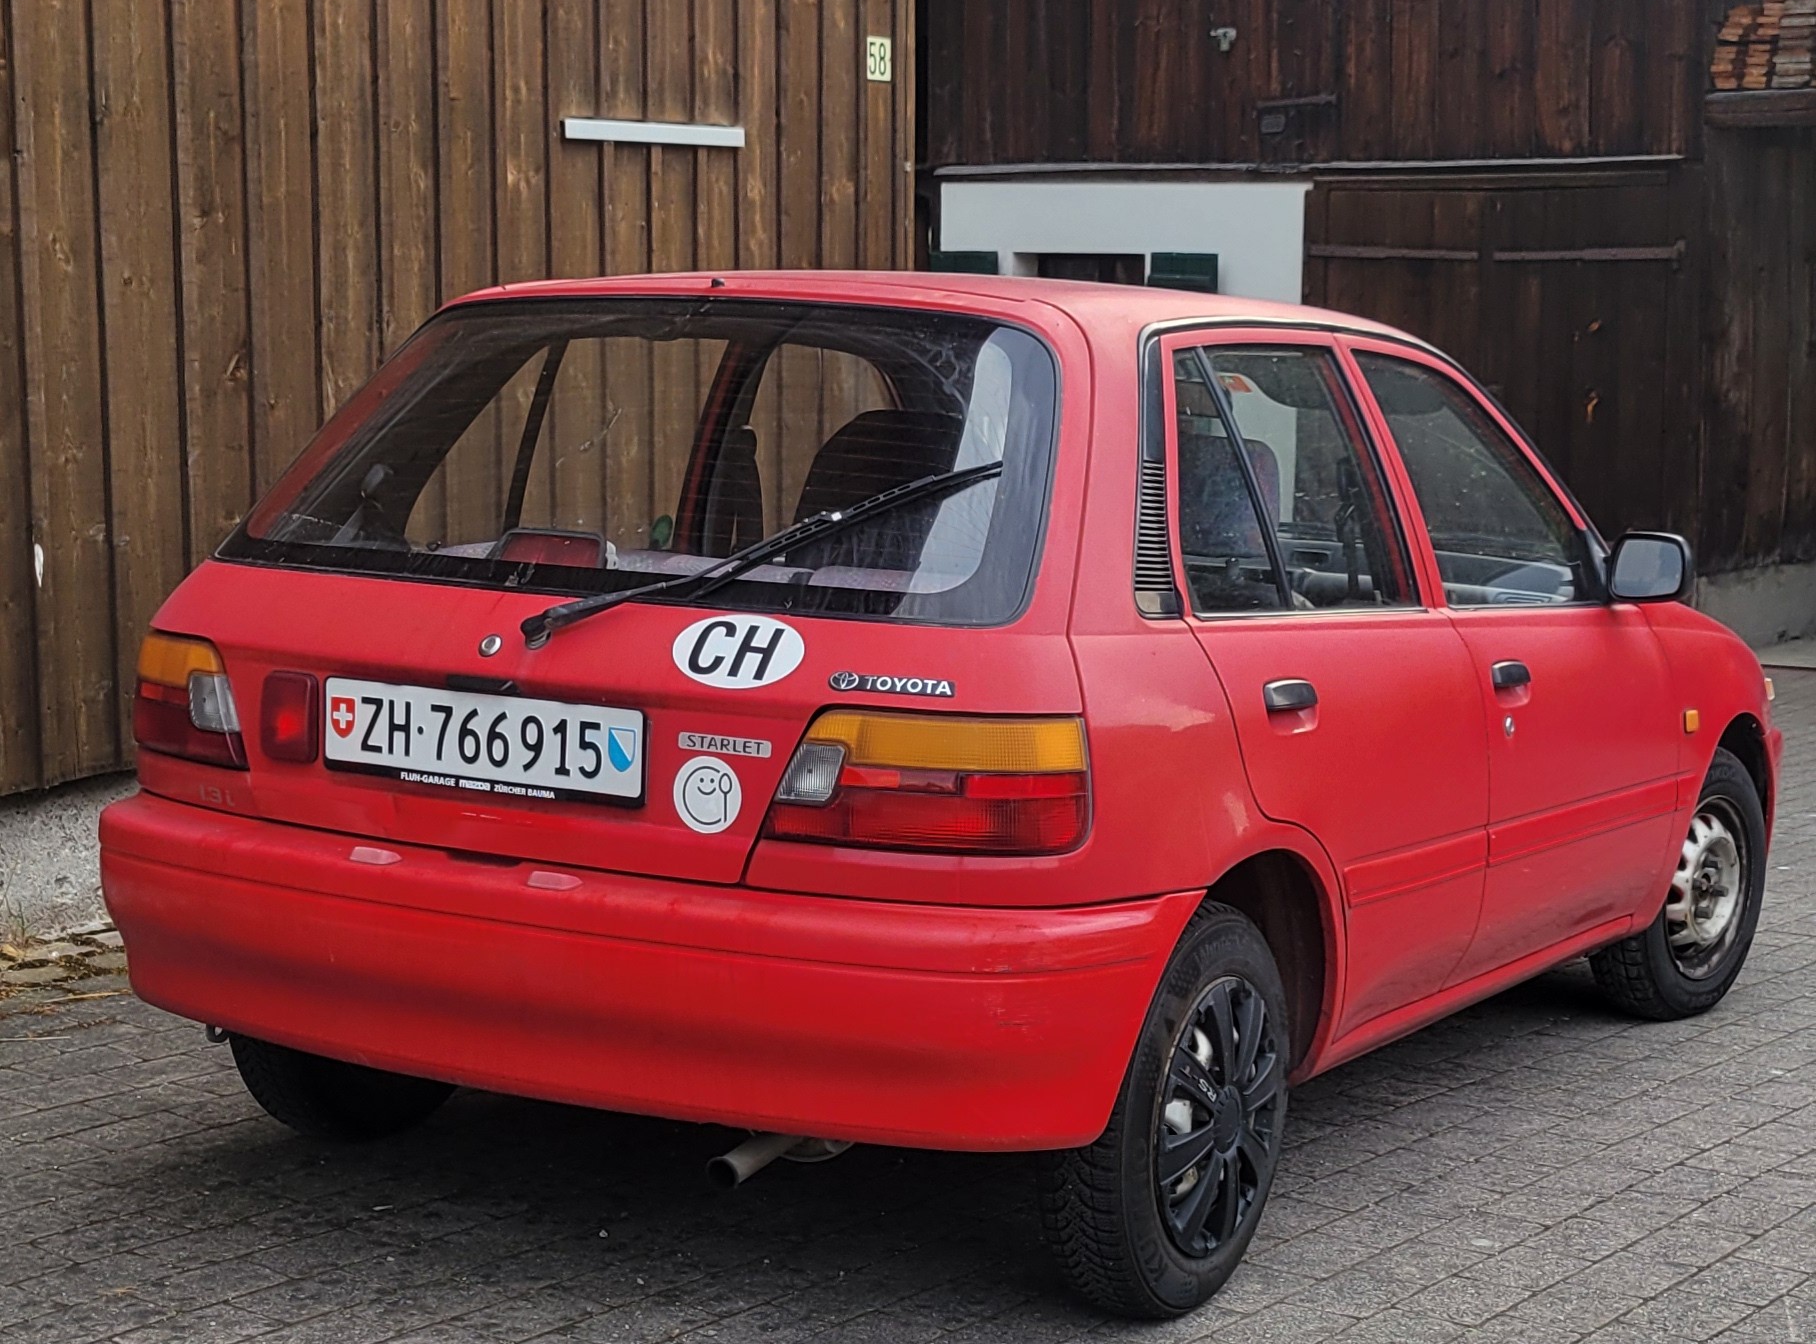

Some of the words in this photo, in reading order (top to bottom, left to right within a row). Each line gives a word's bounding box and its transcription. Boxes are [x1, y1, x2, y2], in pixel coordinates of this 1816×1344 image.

[868, 41, 887, 76] 58
[686, 619, 786, 682] CH
[865, 674, 953, 697] TOYOTA
[685, 733, 765, 756] STARLET
[400, 771, 456, 787] FLUH-GARAGE
[527, 788, 556, 799] BAUMA
[1178, 1065, 1218, 1103] RS-T
